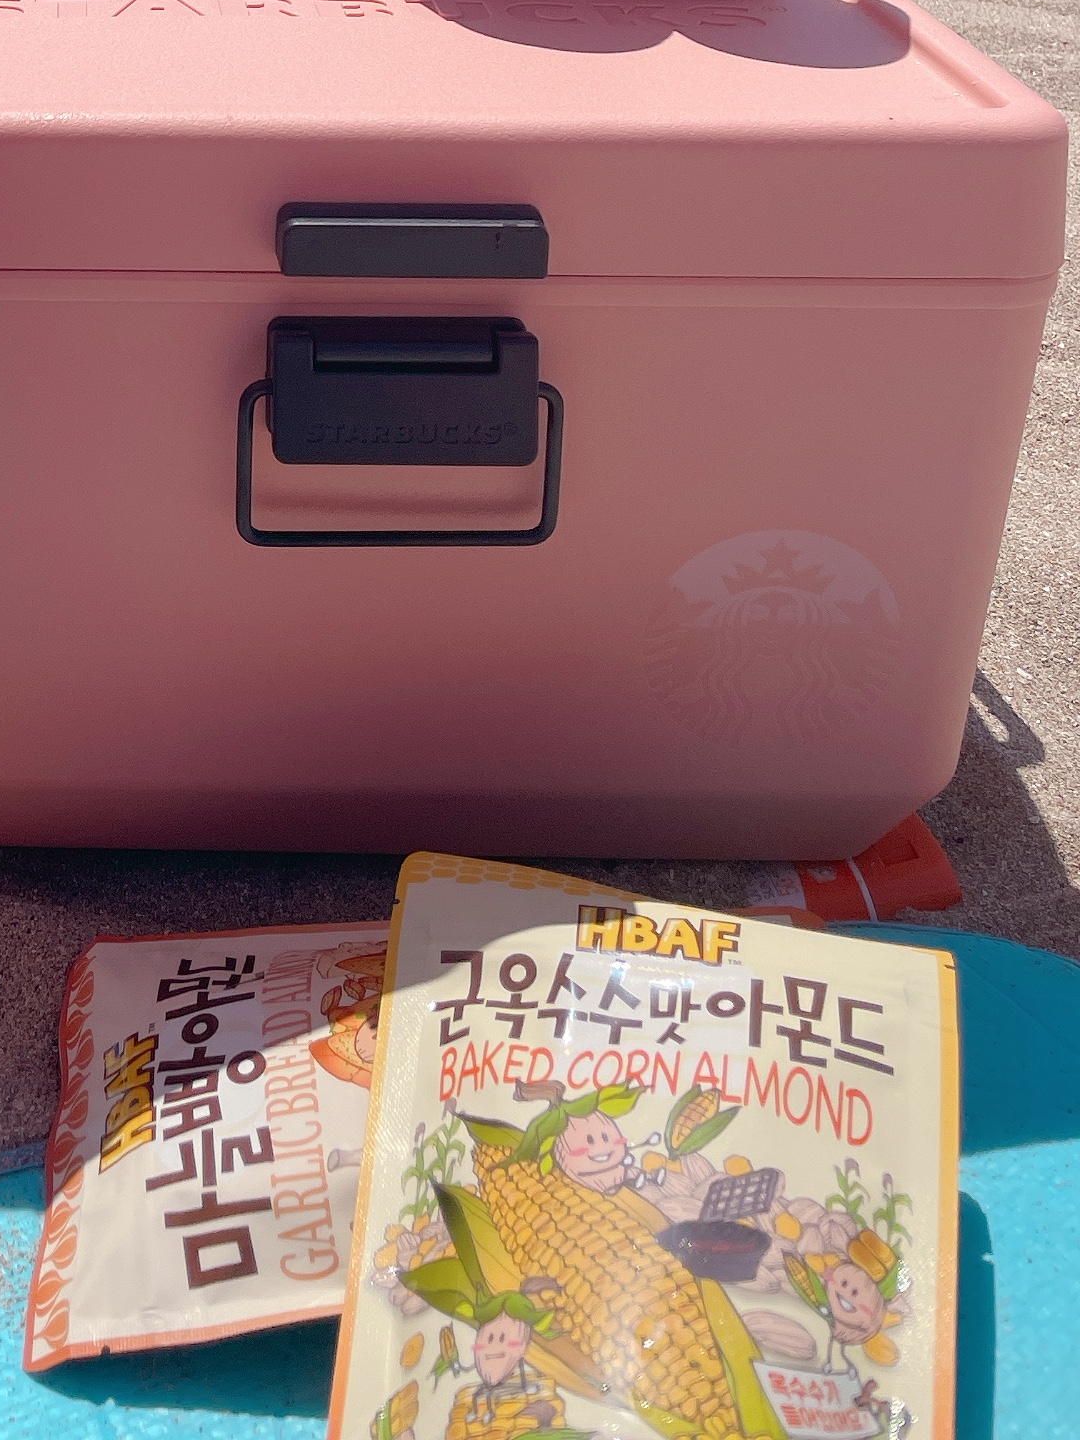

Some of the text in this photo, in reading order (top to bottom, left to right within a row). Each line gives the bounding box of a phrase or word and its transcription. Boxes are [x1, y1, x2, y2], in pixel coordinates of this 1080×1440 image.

[576, 903, 742, 963] HBAF
[98, 1030, 160, 1175] HBAF
[261, 1008, 321, 1118] BREAD
[438, 1039, 875, 1147] BAKED CORN ALMOND
[270, 1121, 339, 1282] GARLIC
